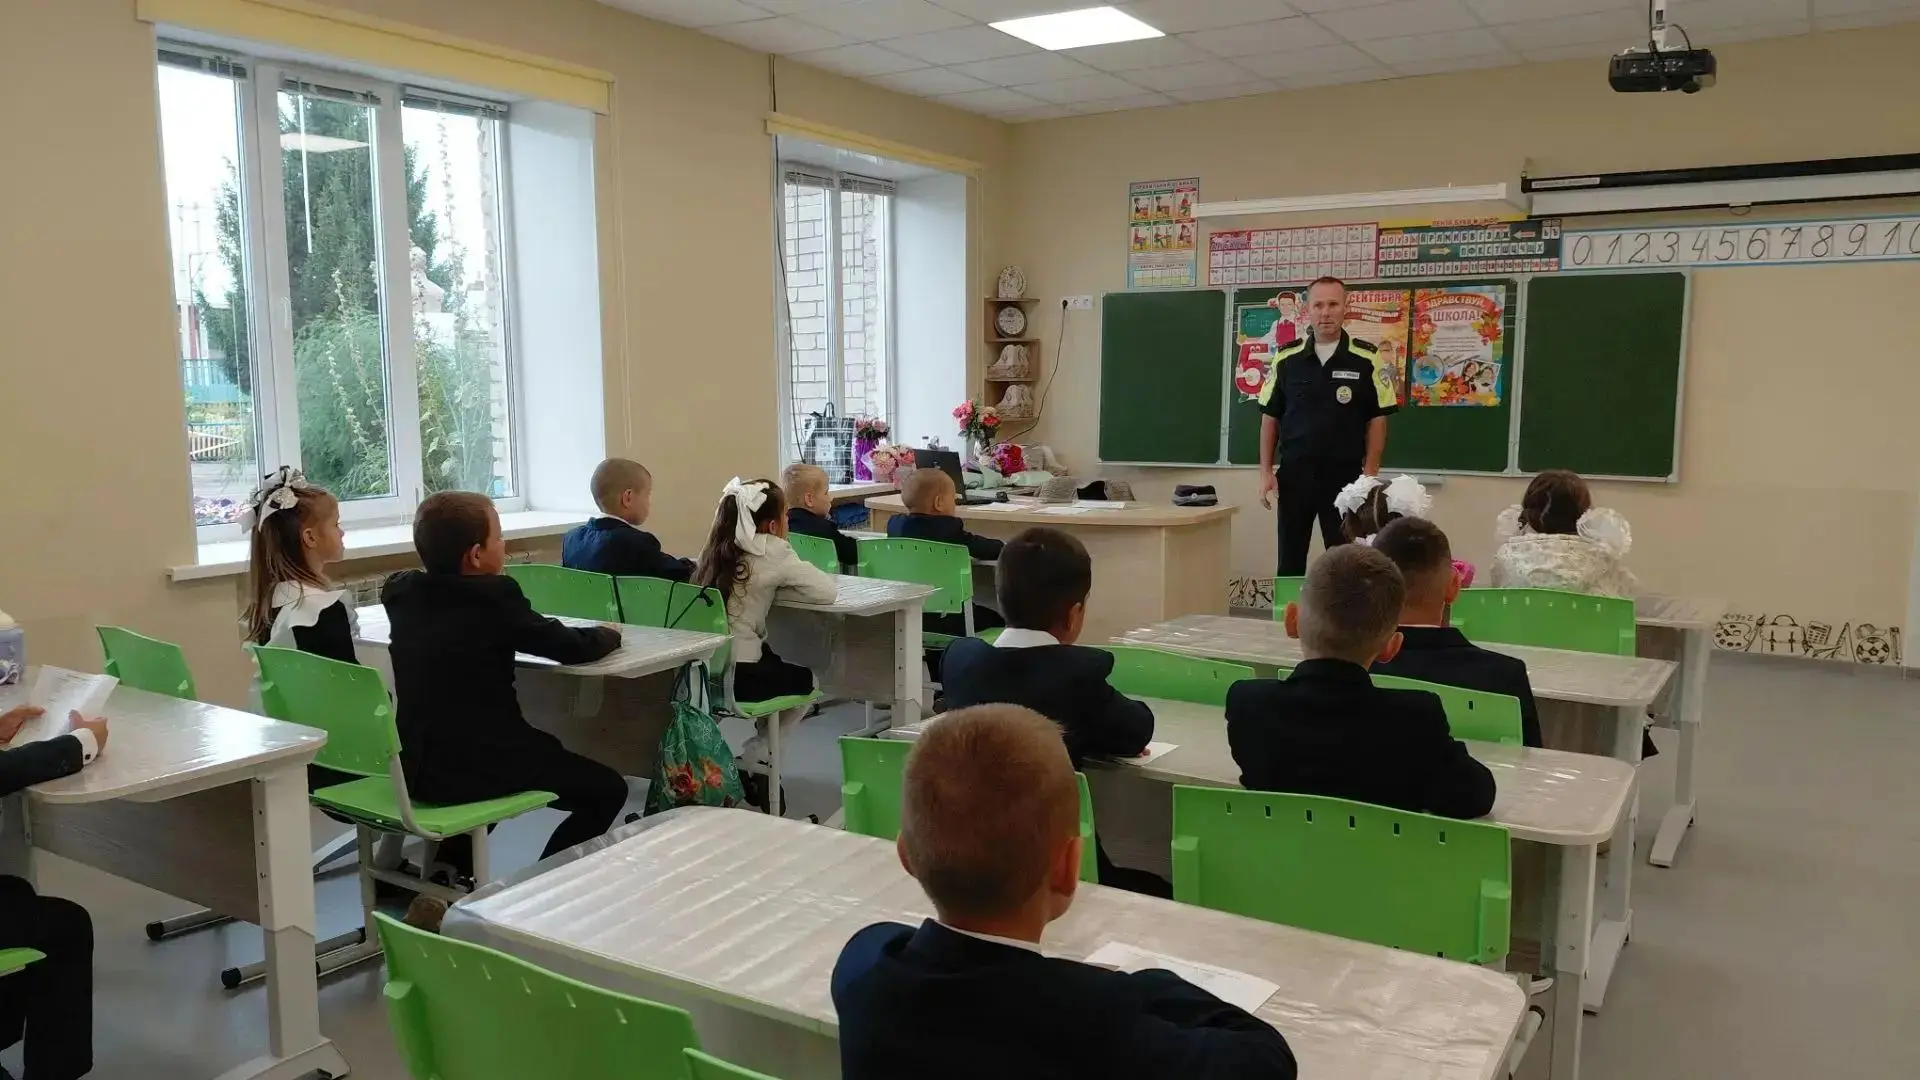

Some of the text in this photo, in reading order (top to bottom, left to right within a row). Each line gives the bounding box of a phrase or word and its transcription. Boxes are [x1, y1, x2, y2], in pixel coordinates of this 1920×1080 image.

[1572, 235, 1591, 265] 0
[1606, 234, 1621, 264] 1
[1628, 233, 1650, 263] 2
[1656, 232, 1679, 262] 3
[1691, 231, 1708, 261] 4
[1714, 230, 1739, 260] 5
[1747, 228, 1770, 259] 6
[1781, 227, 1802, 259] 7
[1811, 225, 1833, 257] 8
[1842, 224, 1866, 256] 9
[1350, 293, 1401, 303] СЕНТЯБРЯ
[1433, 310, 1480, 322] ШКОЛА!
